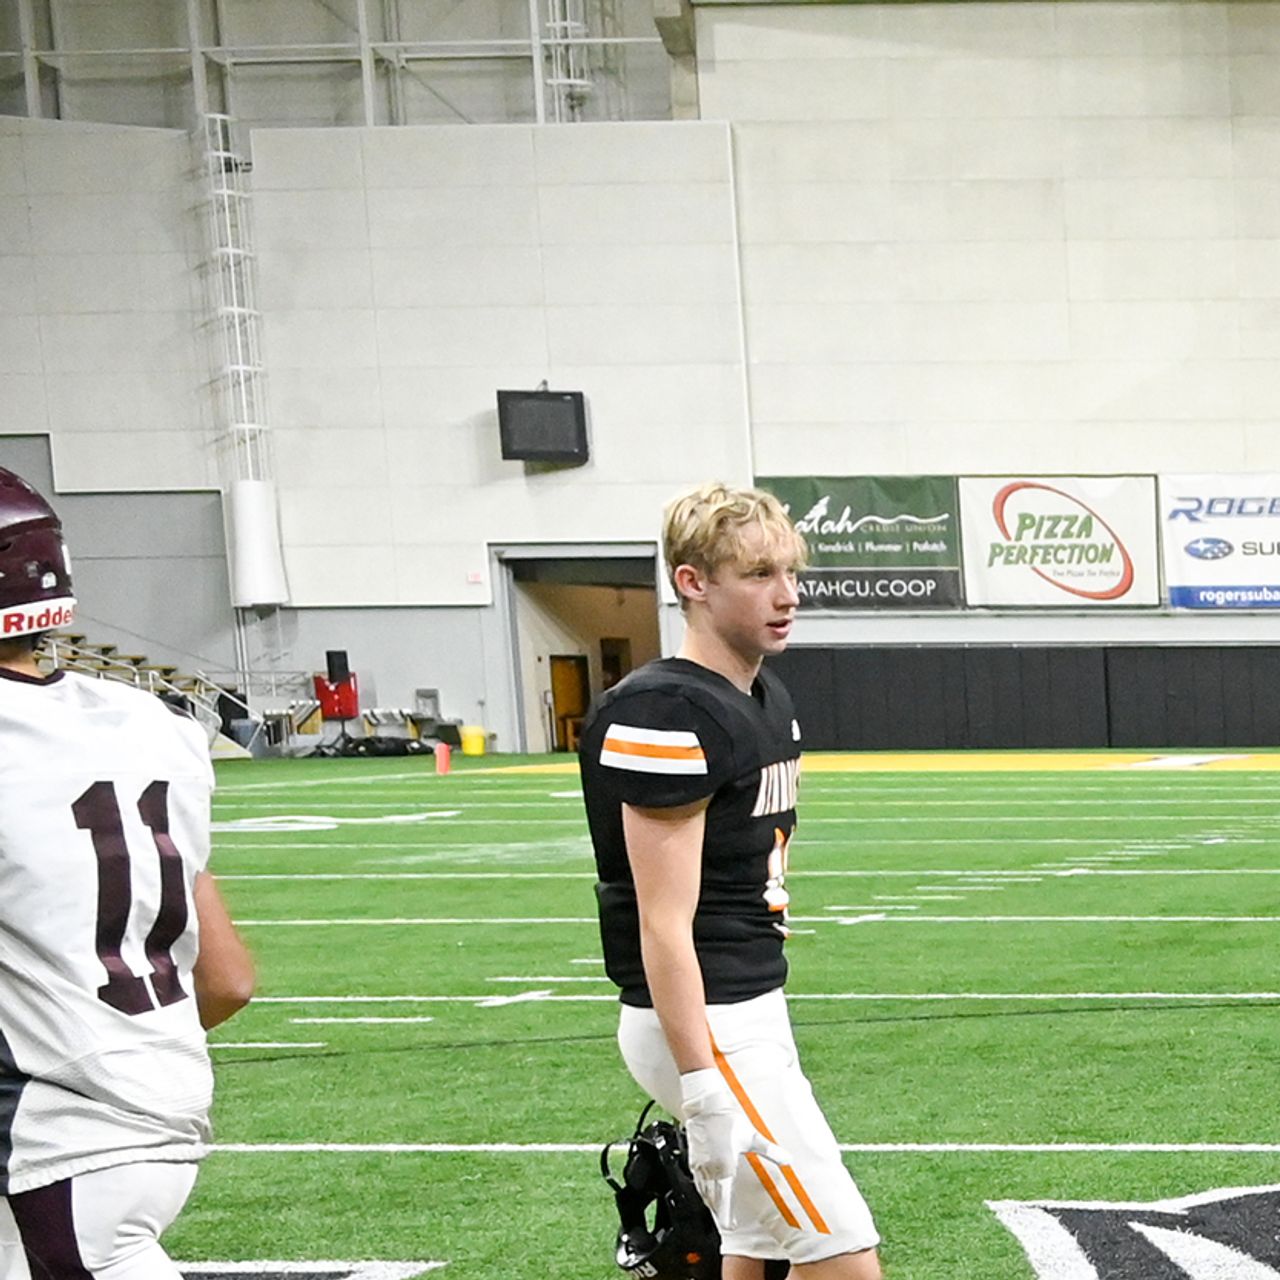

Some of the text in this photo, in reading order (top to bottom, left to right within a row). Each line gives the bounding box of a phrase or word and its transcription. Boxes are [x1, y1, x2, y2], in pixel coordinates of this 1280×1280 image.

[1014, 512, 1094, 542] PIZZA
[987, 543, 1115, 568] PERFECTION
[796, 579, 937, 598] ATAHCU.COOP
[70, 779, 191, 1016] 11
